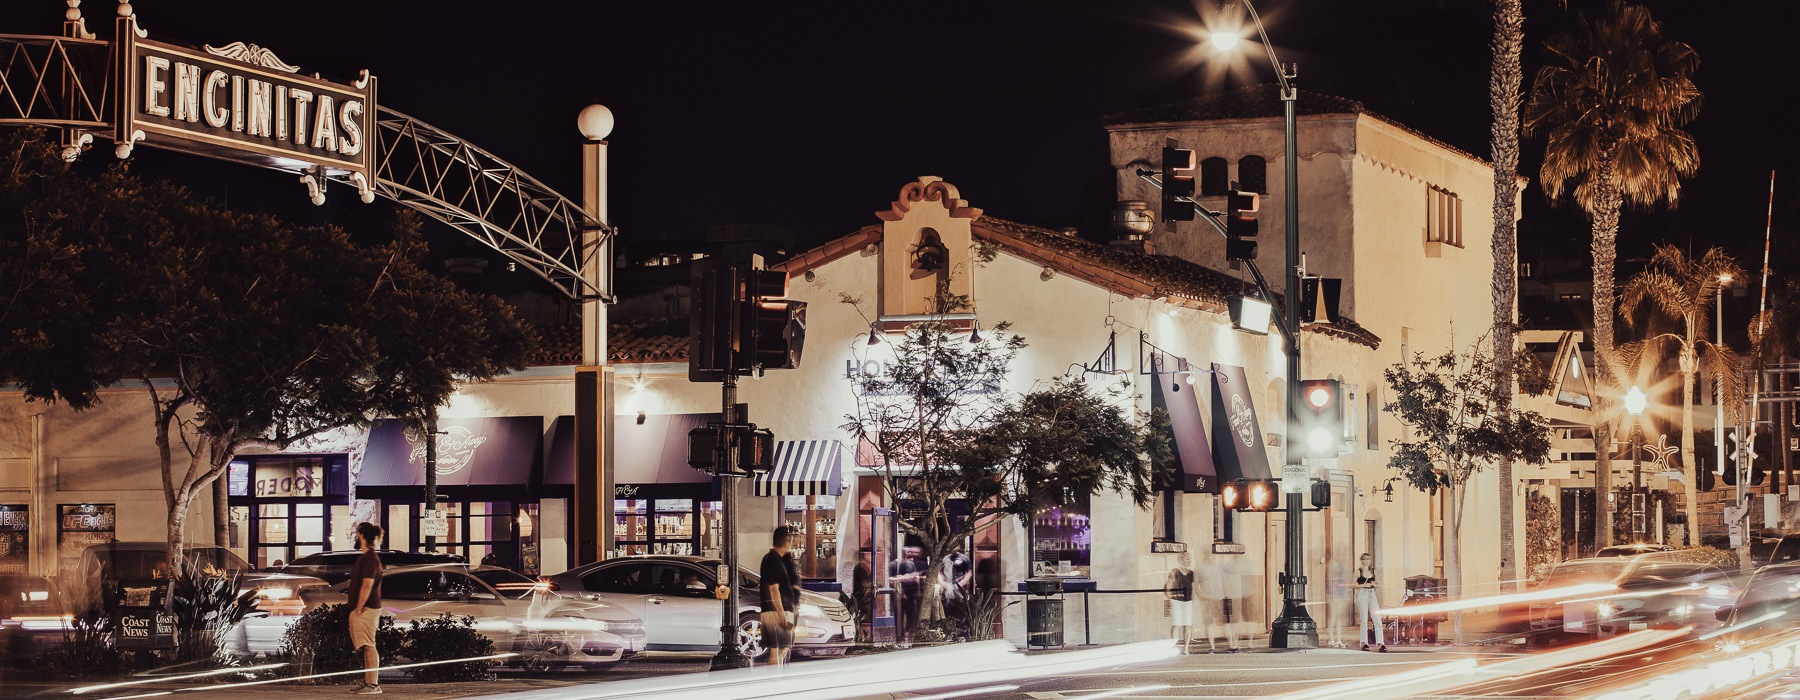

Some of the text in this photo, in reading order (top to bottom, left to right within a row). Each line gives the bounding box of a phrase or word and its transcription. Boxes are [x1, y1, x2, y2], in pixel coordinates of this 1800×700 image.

[145, 54, 363, 156] ENCINITAS
[62, 514, 91, 529] UFC
[1035, 563, 1043, 572] A
[122, 616, 150, 627] COAST
[122, 626, 149, 637] NEWS
